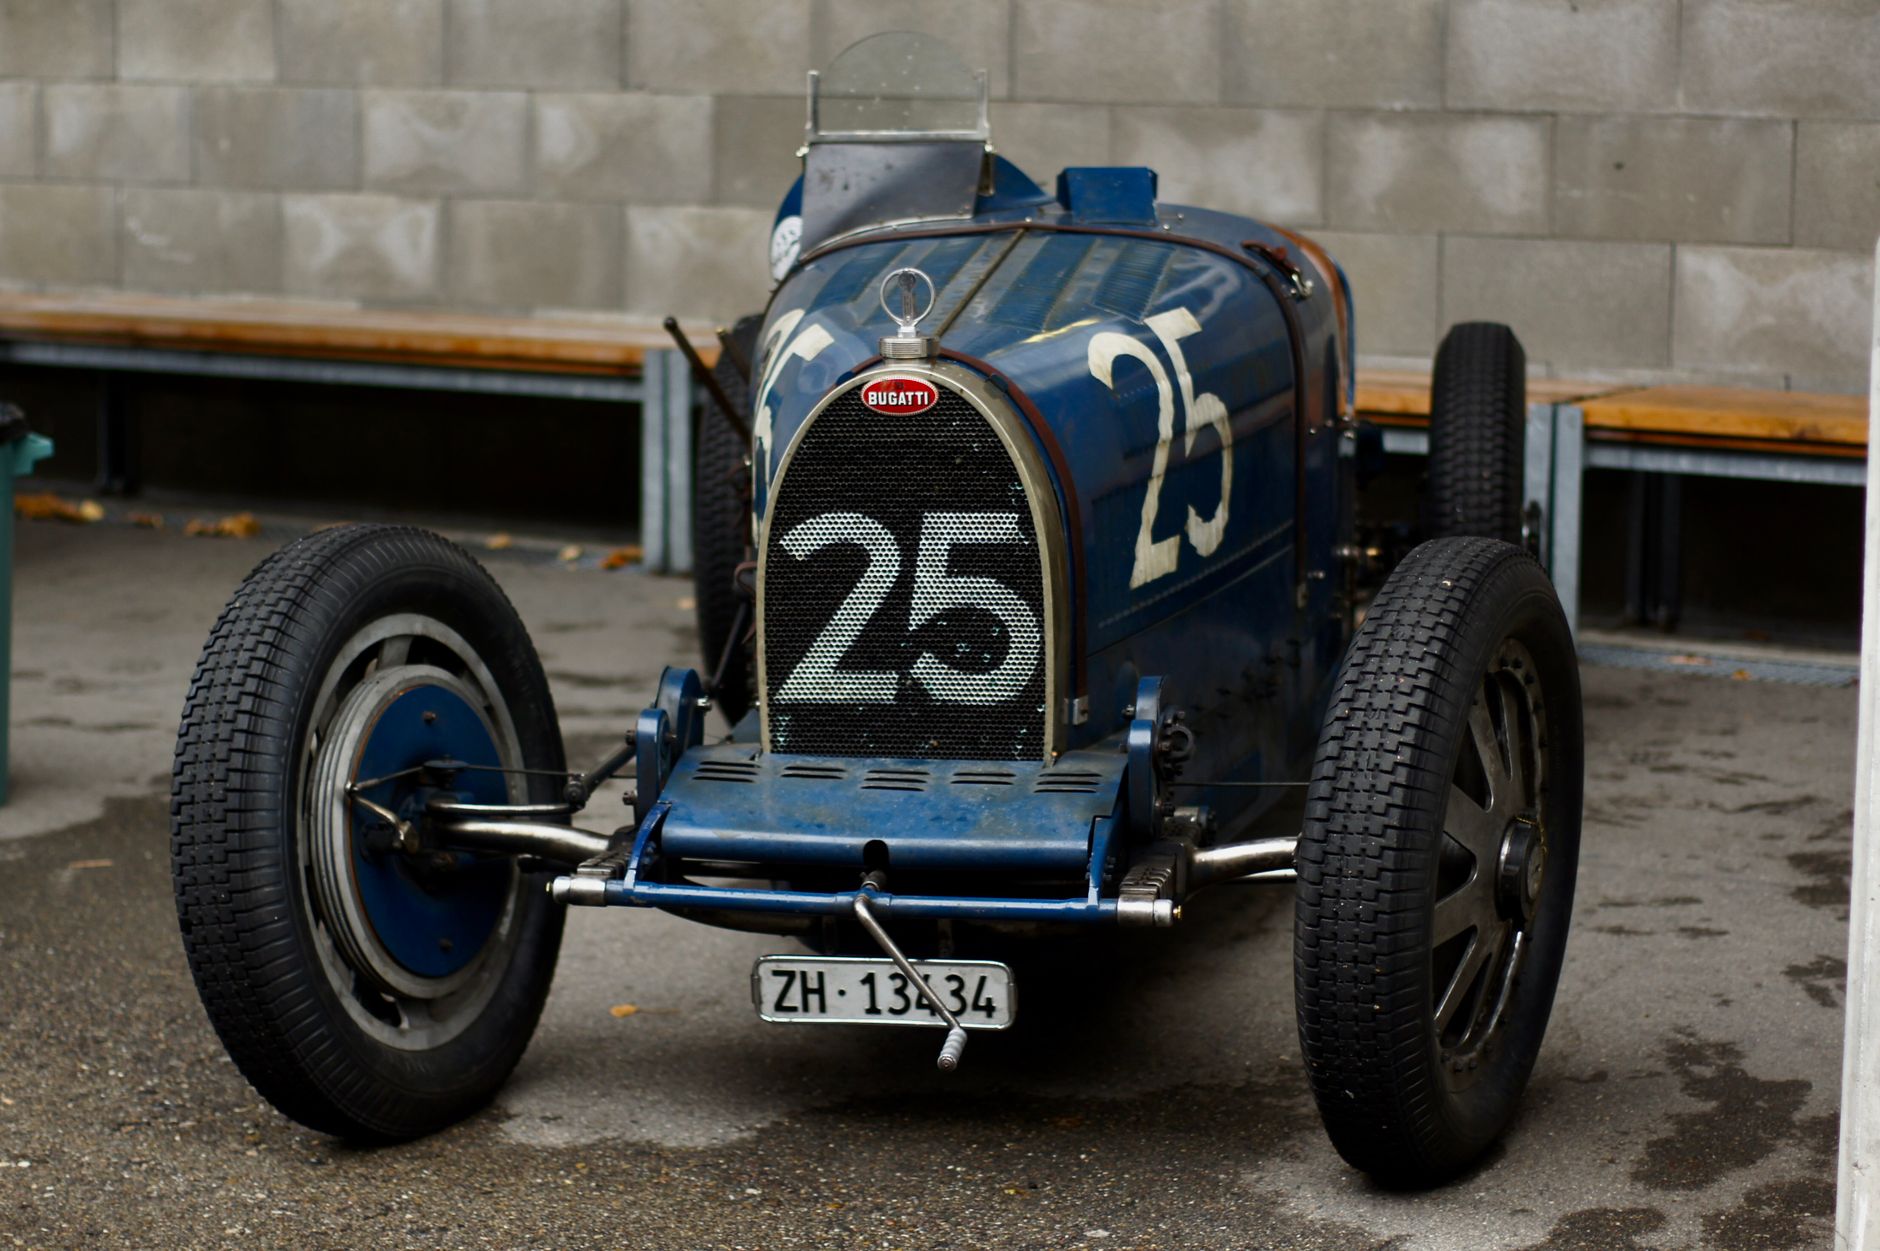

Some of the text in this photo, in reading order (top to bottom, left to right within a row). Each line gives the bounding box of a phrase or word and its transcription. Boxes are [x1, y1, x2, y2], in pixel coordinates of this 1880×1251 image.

[868, 391, 929, 406] BUGATTI
[1087, 306, 1233, 589] 25
[773, 511, 1042, 705] 25
